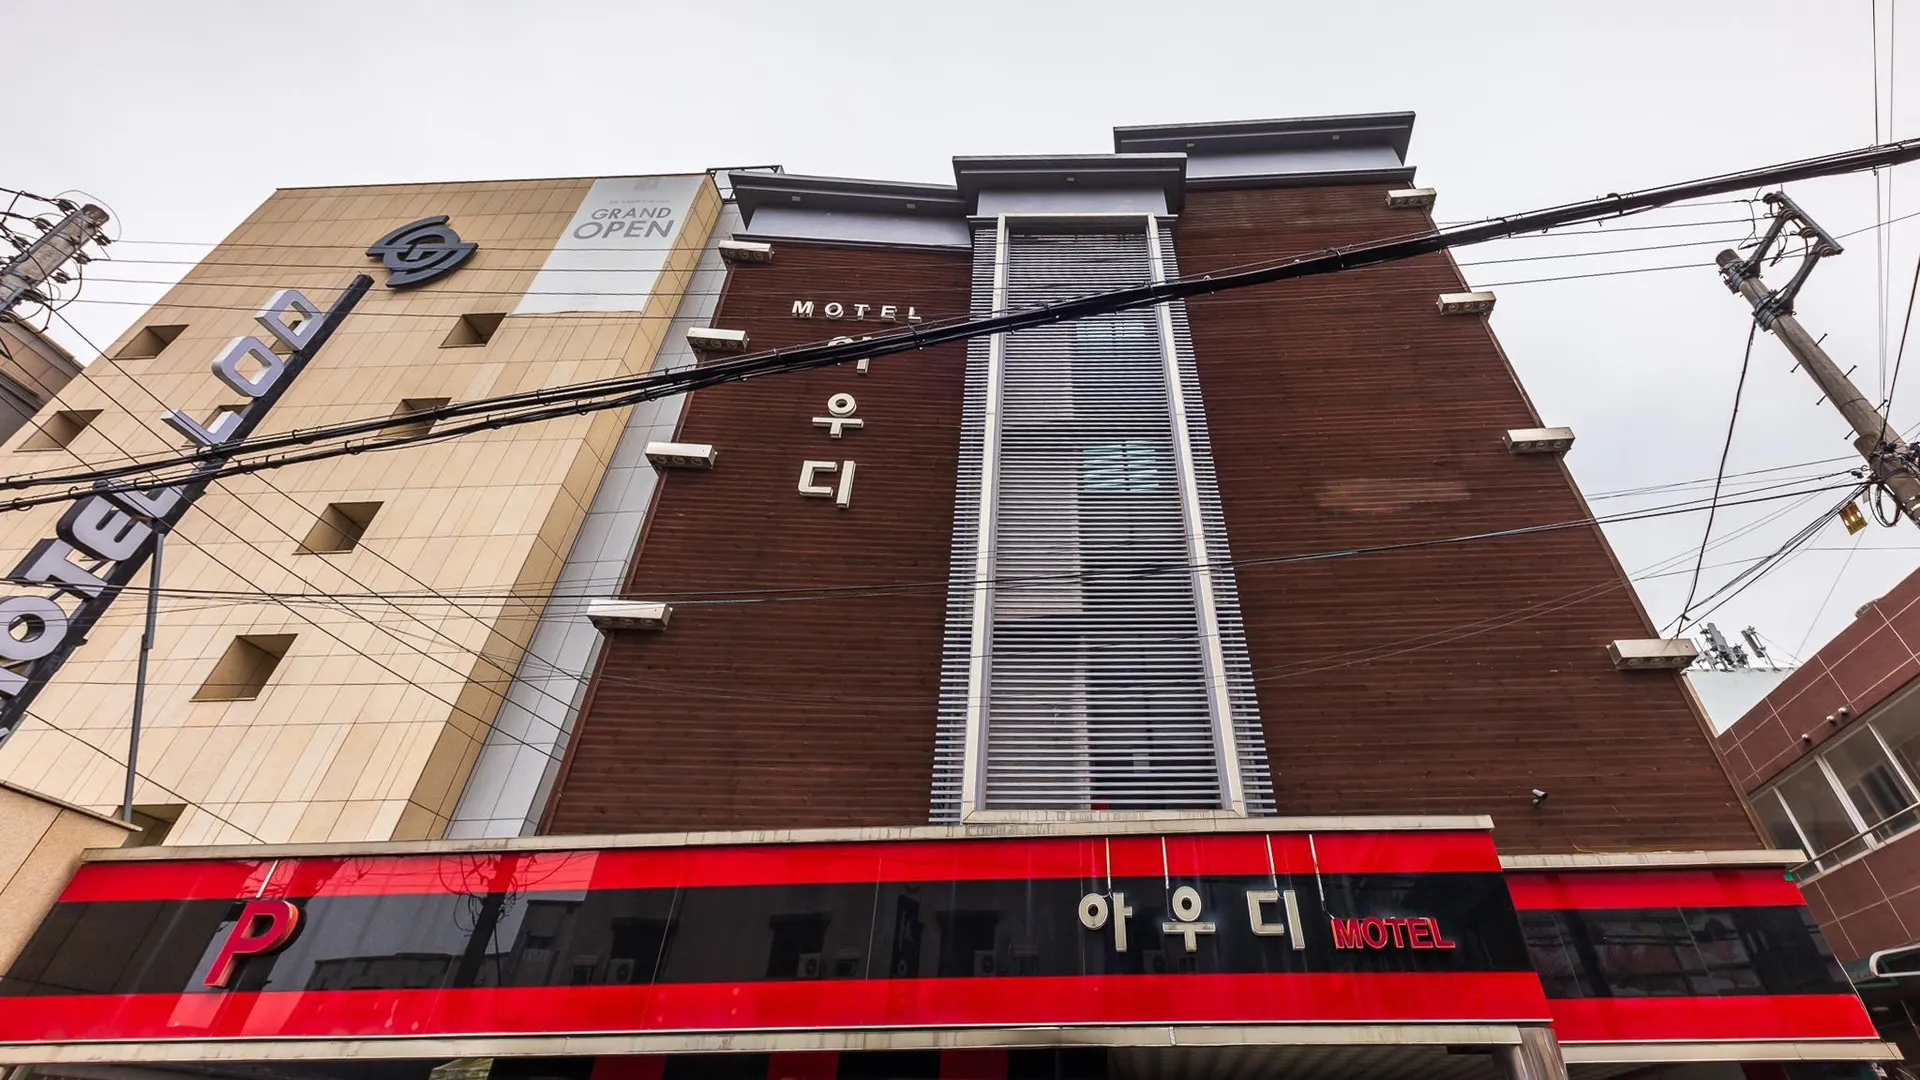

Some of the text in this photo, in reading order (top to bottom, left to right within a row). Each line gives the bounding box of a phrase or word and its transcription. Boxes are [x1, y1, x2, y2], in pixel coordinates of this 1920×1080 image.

[591, 207, 672, 220] GRAND
[573, 220, 675, 239] OPEN
[791, 300, 922, 324] MOTEL
[1078, 885, 1456, 952] 아우디 MOTEL
[203, 900, 299, 987] P
